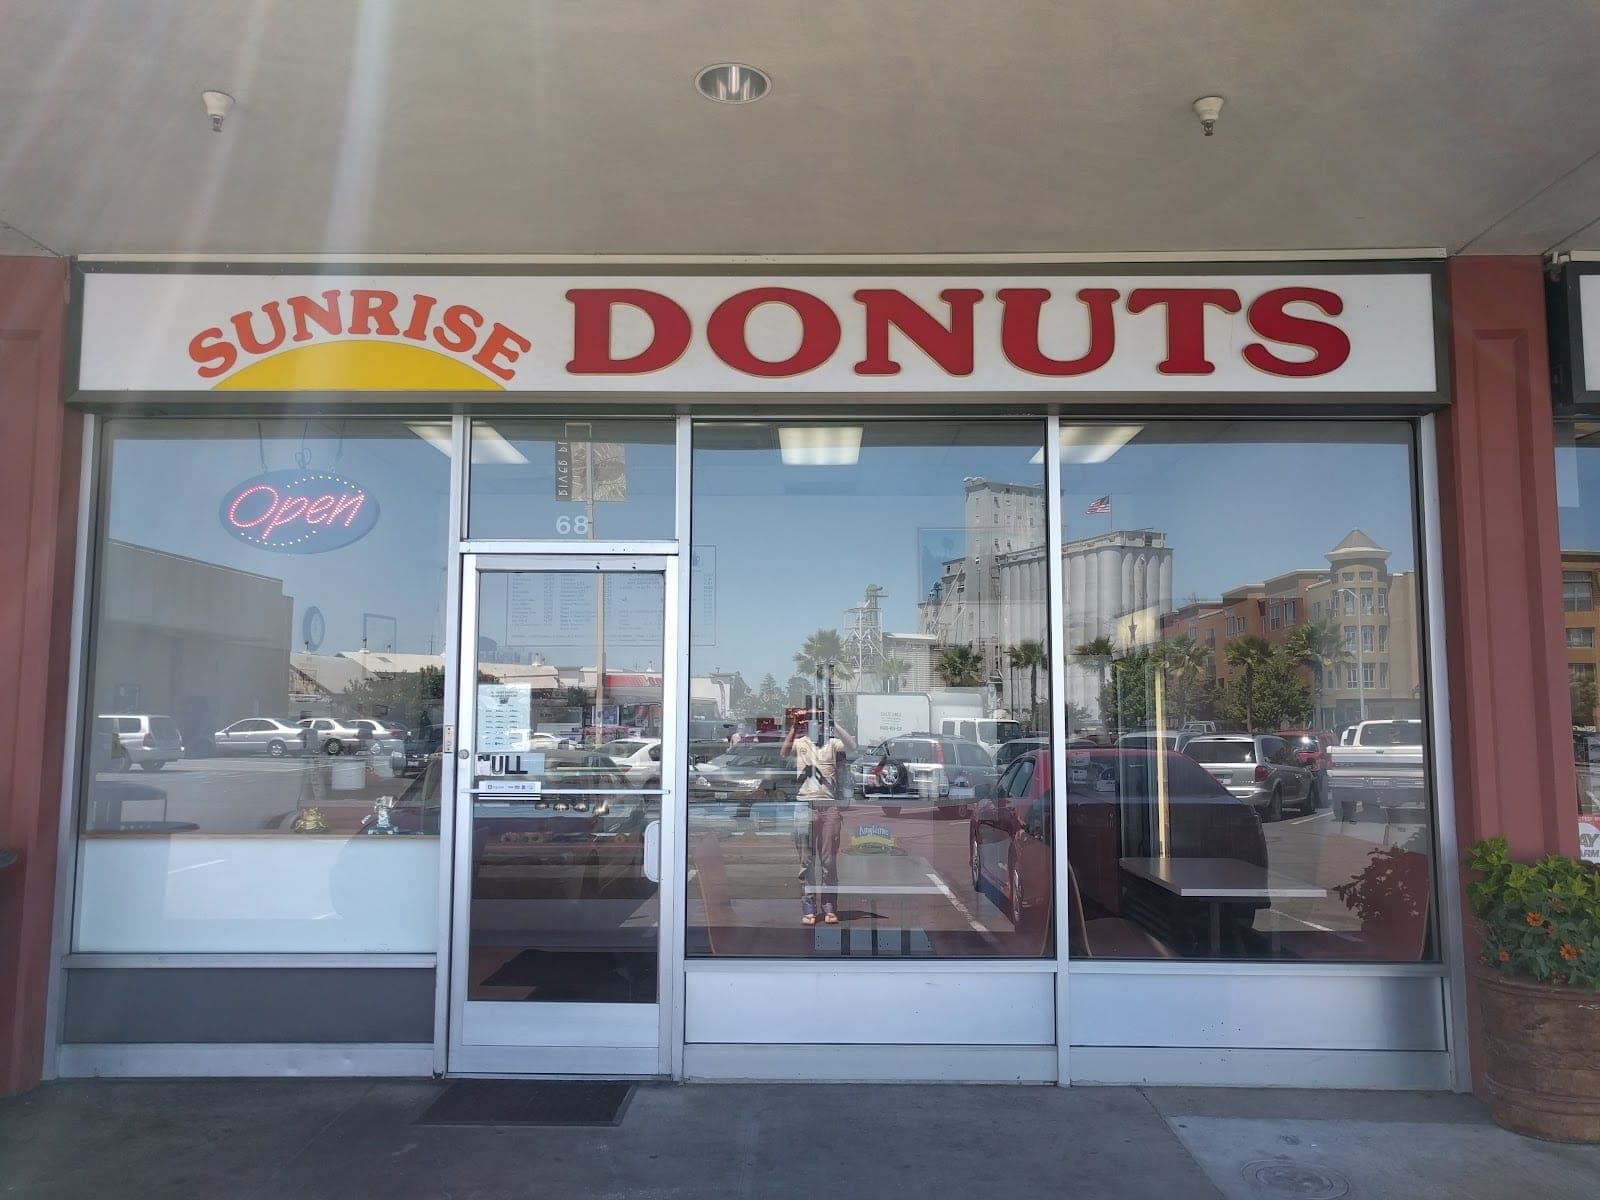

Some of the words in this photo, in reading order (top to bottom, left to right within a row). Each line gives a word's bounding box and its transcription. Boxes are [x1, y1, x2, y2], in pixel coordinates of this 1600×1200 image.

[188, 289, 532, 381] SUNRISE
[564, 286, 1352, 379] DONUTS
[227, 483, 365, 541] Open
[555, 515, 589, 535] 68
[1580, 833, 1600, 848] AY
